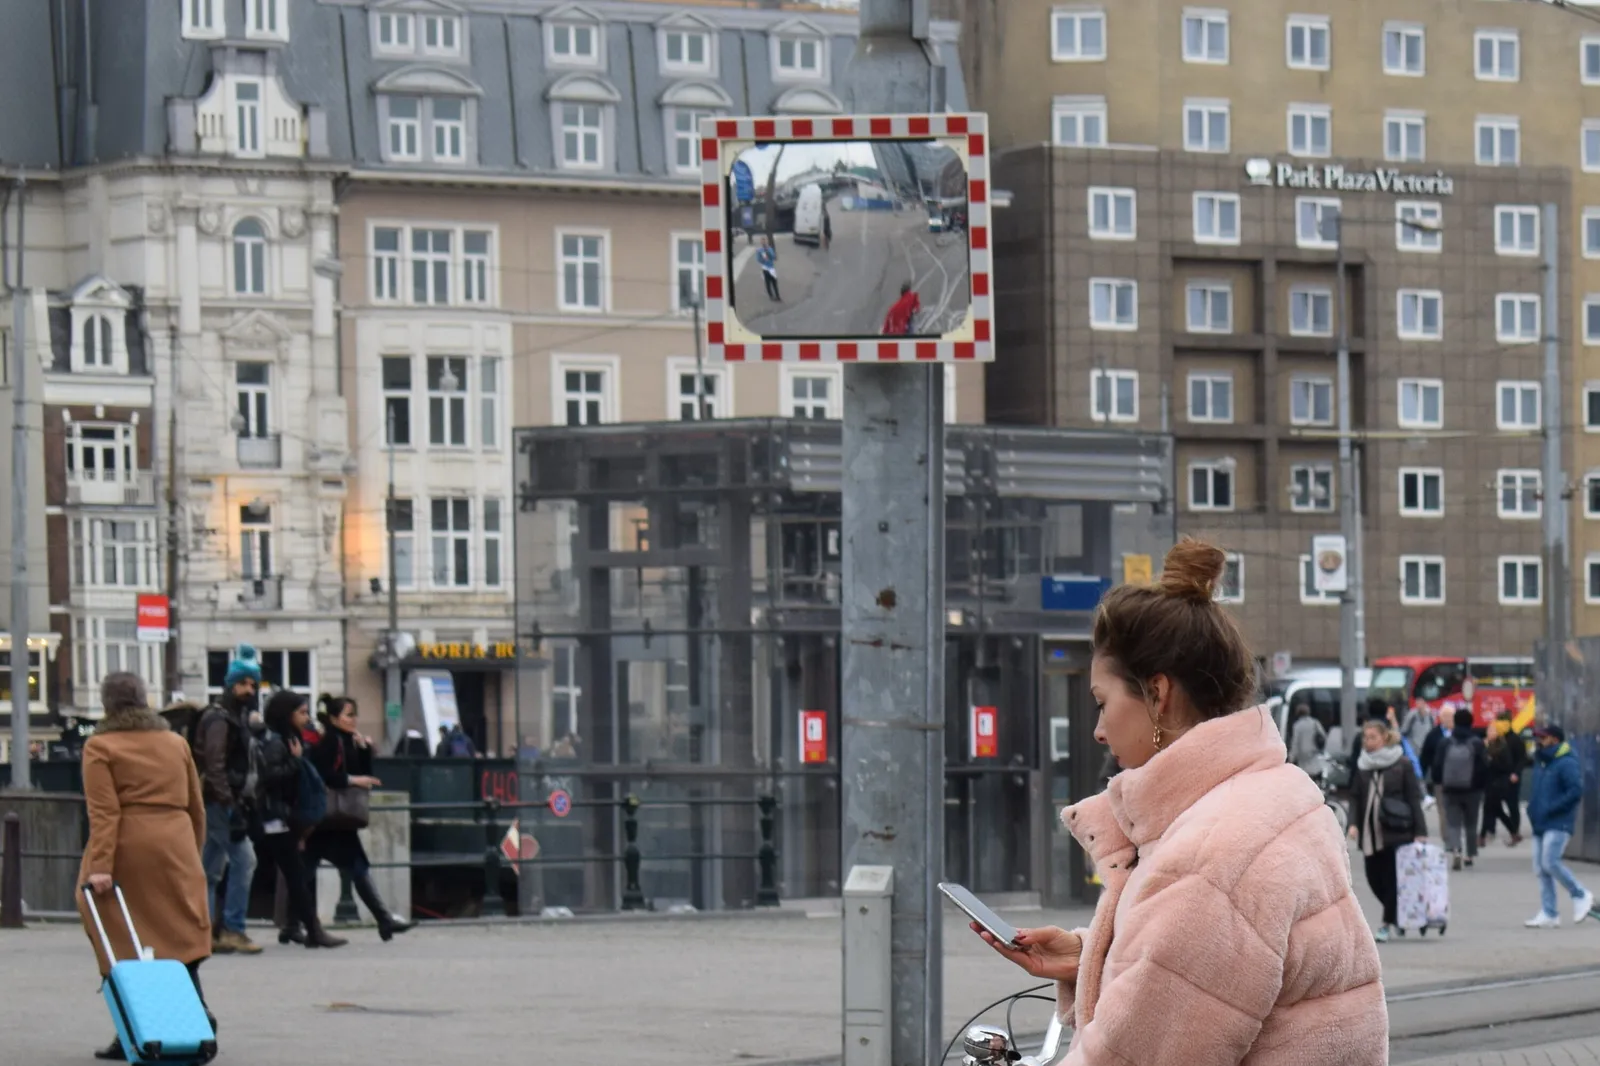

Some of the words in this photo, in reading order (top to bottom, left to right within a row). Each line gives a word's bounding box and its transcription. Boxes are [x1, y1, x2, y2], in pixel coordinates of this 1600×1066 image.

[1276, 161, 1320, 188] Park
[1323, 163, 1376, 192] Plaza
[1375, 167, 1454, 195] Victoria
